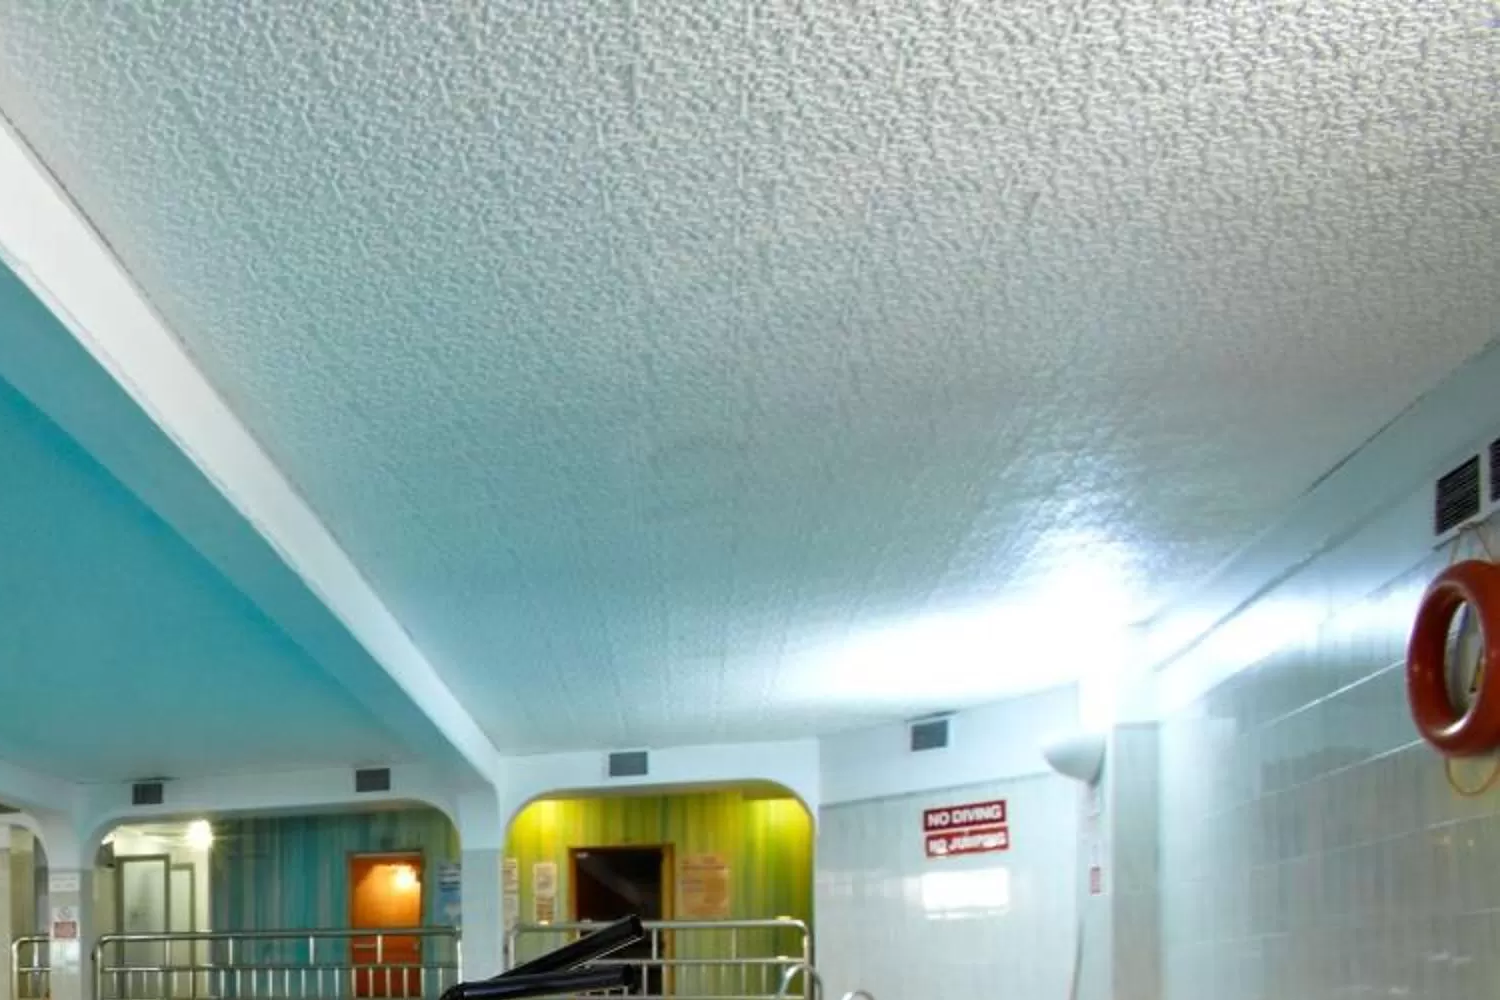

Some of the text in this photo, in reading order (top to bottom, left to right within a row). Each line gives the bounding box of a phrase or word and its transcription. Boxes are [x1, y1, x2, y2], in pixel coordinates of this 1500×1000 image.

[928, 804, 1002, 827] NO DIVING
[930, 839, 948, 854] NO
